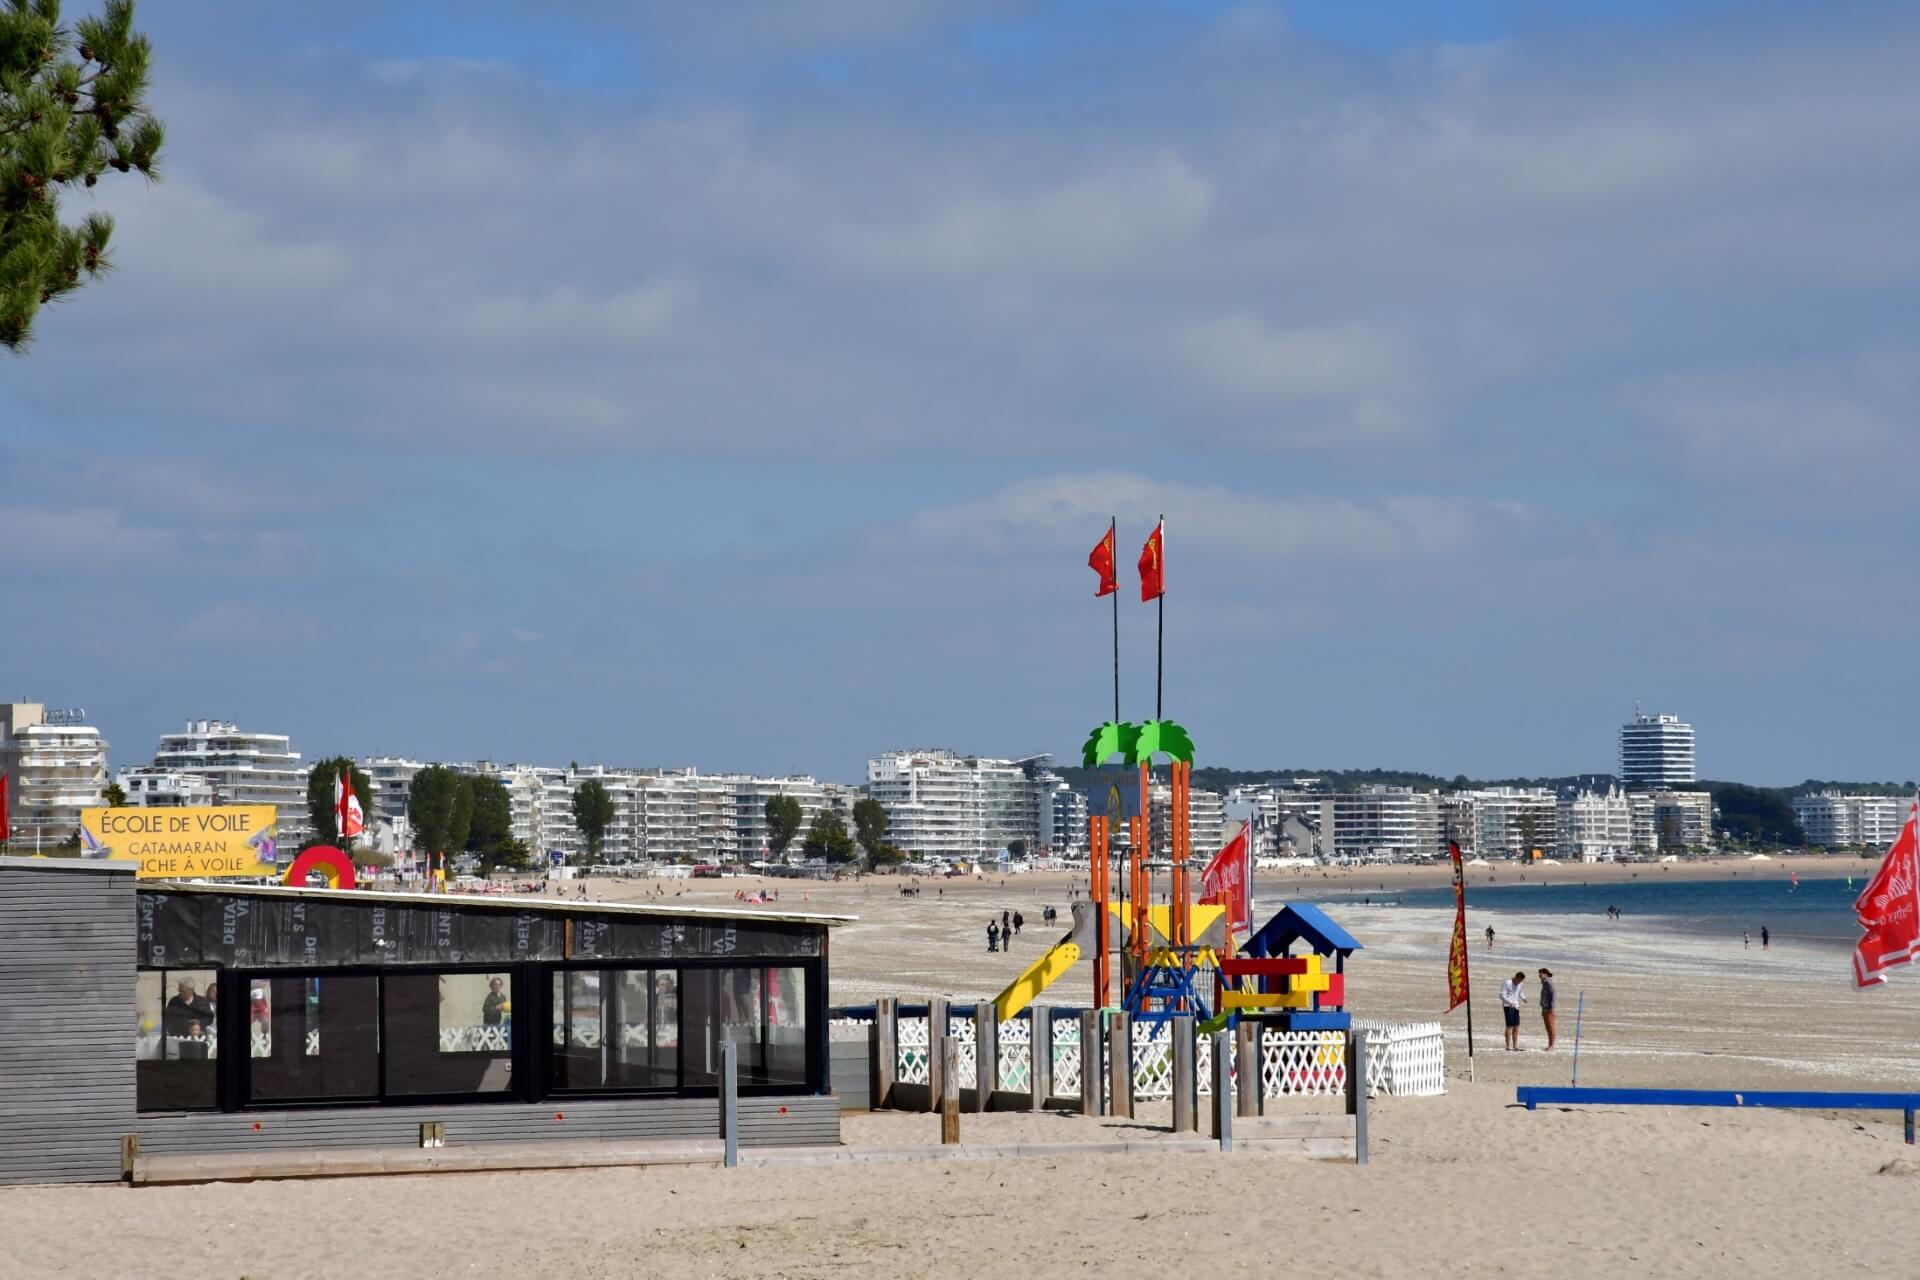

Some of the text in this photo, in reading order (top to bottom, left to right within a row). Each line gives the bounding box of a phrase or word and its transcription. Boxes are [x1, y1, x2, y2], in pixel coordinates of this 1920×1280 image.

[101, 811, 250, 833] ÉCOLE DE VOILE
[129, 841, 226, 855] CATAMARAN
[184, 855, 194, 871] À
[200, 858, 243, 872] VOILE
